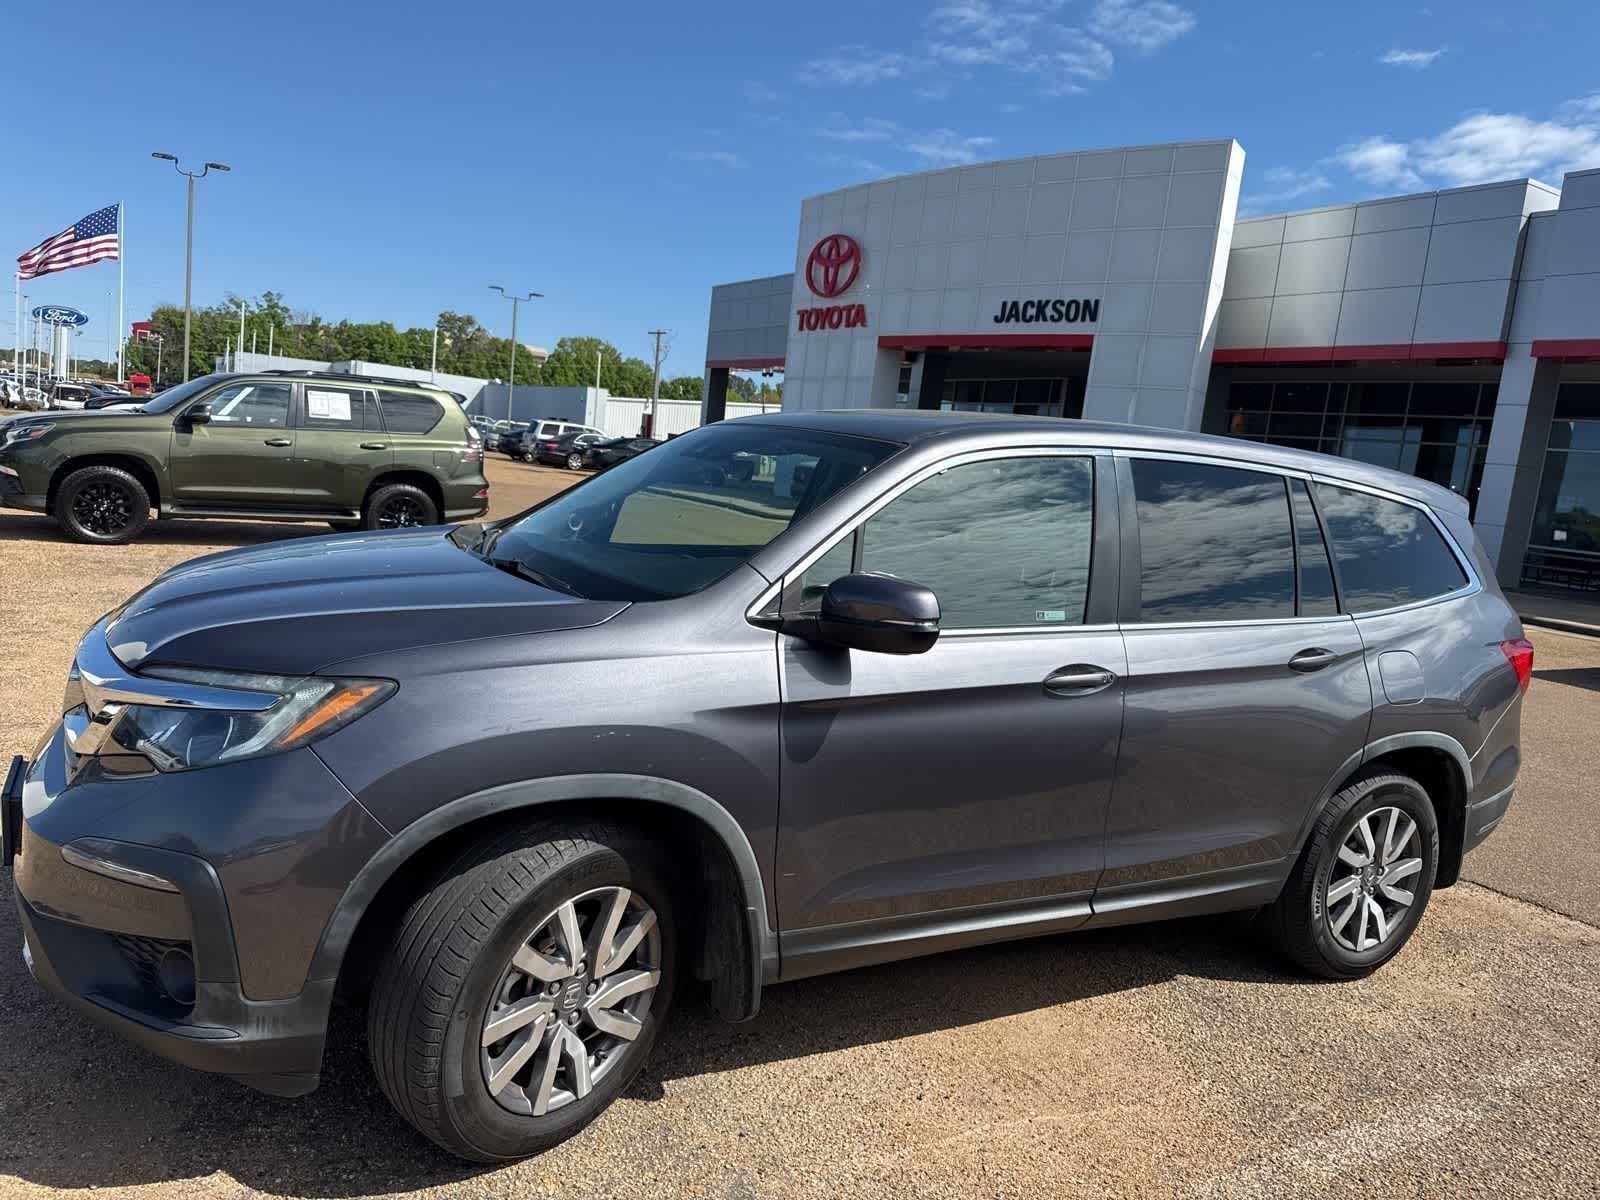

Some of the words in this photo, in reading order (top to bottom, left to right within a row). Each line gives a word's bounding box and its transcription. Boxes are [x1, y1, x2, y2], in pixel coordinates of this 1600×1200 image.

[44, 308, 78, 323] Ford
[797, 304, 867, 331] TOYOTA
[993, 298, 1100, 324] JACKSON
